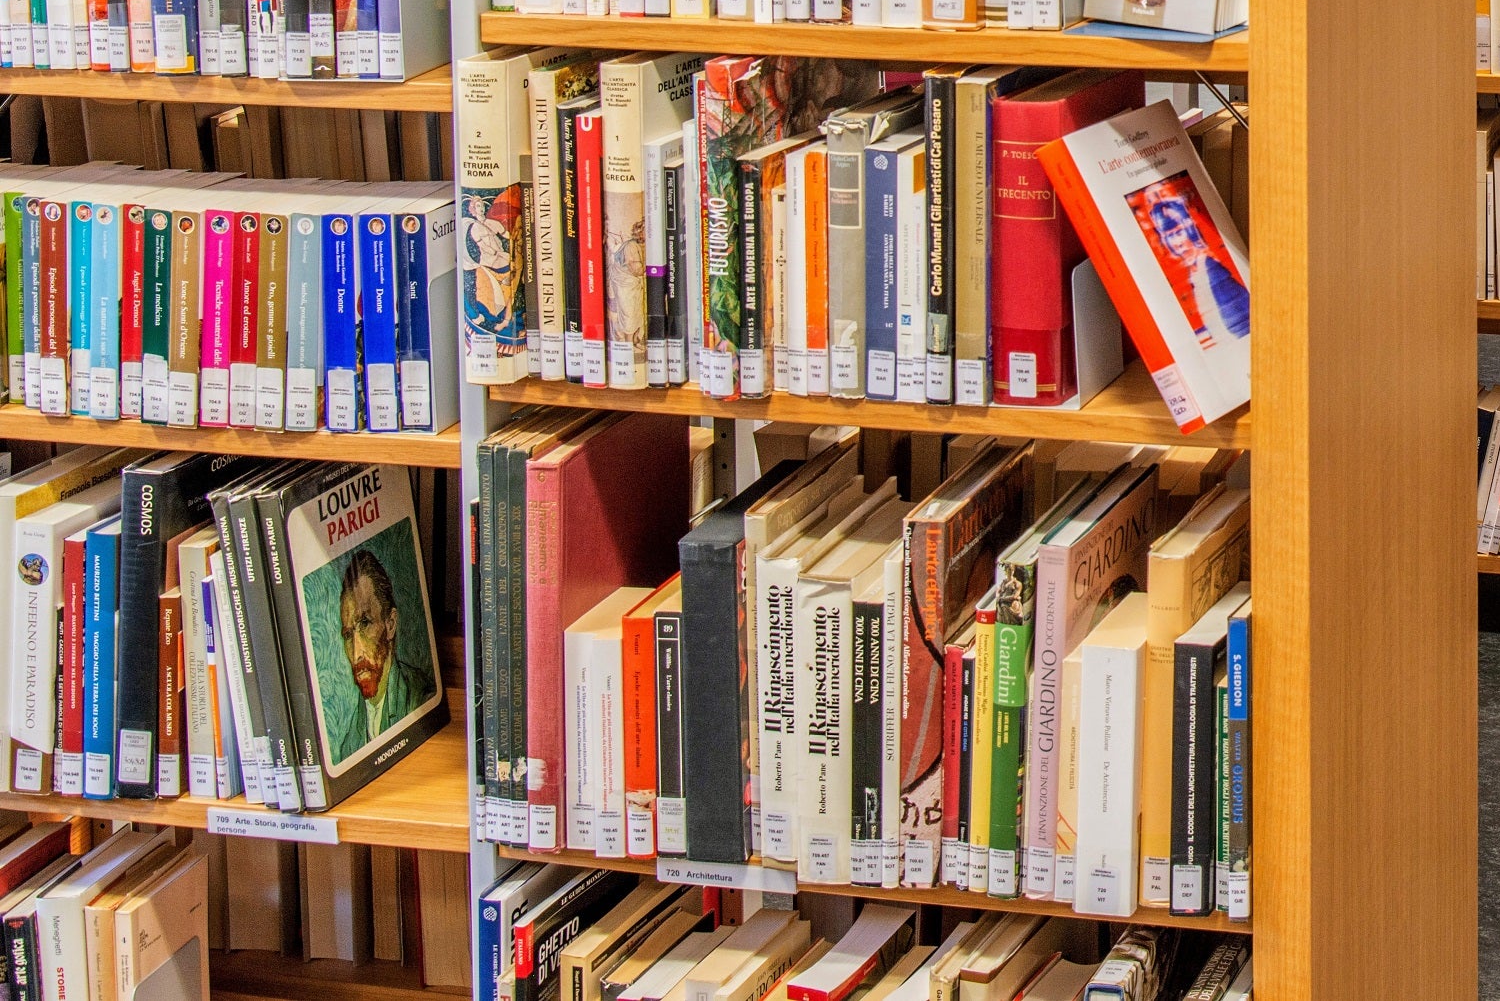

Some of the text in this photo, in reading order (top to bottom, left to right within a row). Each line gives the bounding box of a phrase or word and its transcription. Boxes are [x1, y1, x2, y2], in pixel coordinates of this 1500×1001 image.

[463, 162, 500, 170] ETRURIA
[606, 174, 636, 182] GRECIA
[997, 189, 1050, 199] TRECENTO
[1018, 176, 1029, 186] IL
[536, 99, 555, 325] MUSEI E MONUMENTI ETRUSCHI
[432, 220, 456, 242] Santi
[709, 197, 727, 276] FUTURISMO
[155, 282, 162, 291] La
[243, 279, 251, 303] Amore
[410, 280, 418, 299] Santi
[243, 304, 249, 313] ed
[337, 288, 345, 314] Donne
[376, 288, 384, 314] Donne
[317, 469, 382, 522] LOUVRE
[141, 484, 152, 535] COSMOS
[326, 497, 380, 546] PARIGI
[26, 592, 38, 729] INFERNO E PARADISO
[765, 585, 780, 732] Il Rinascimento
[781, 586, 794, 734] nell'Italia meridionale
[999, 626, 1018, 706] Giardini
[1039, 649, 1057, 752] GIARDINO
[217, 827, 246, 835] persone
[235, 817, 251, 825] Arte.
[254, 819, 276, 828] Storia,
[280, 822, 317, 832] geografia,
[666, 869, 732, 881] 720 Architettura
[53, 916, 63, 956] Meneghetti
[56, 967, 65, 1000] STORIE
